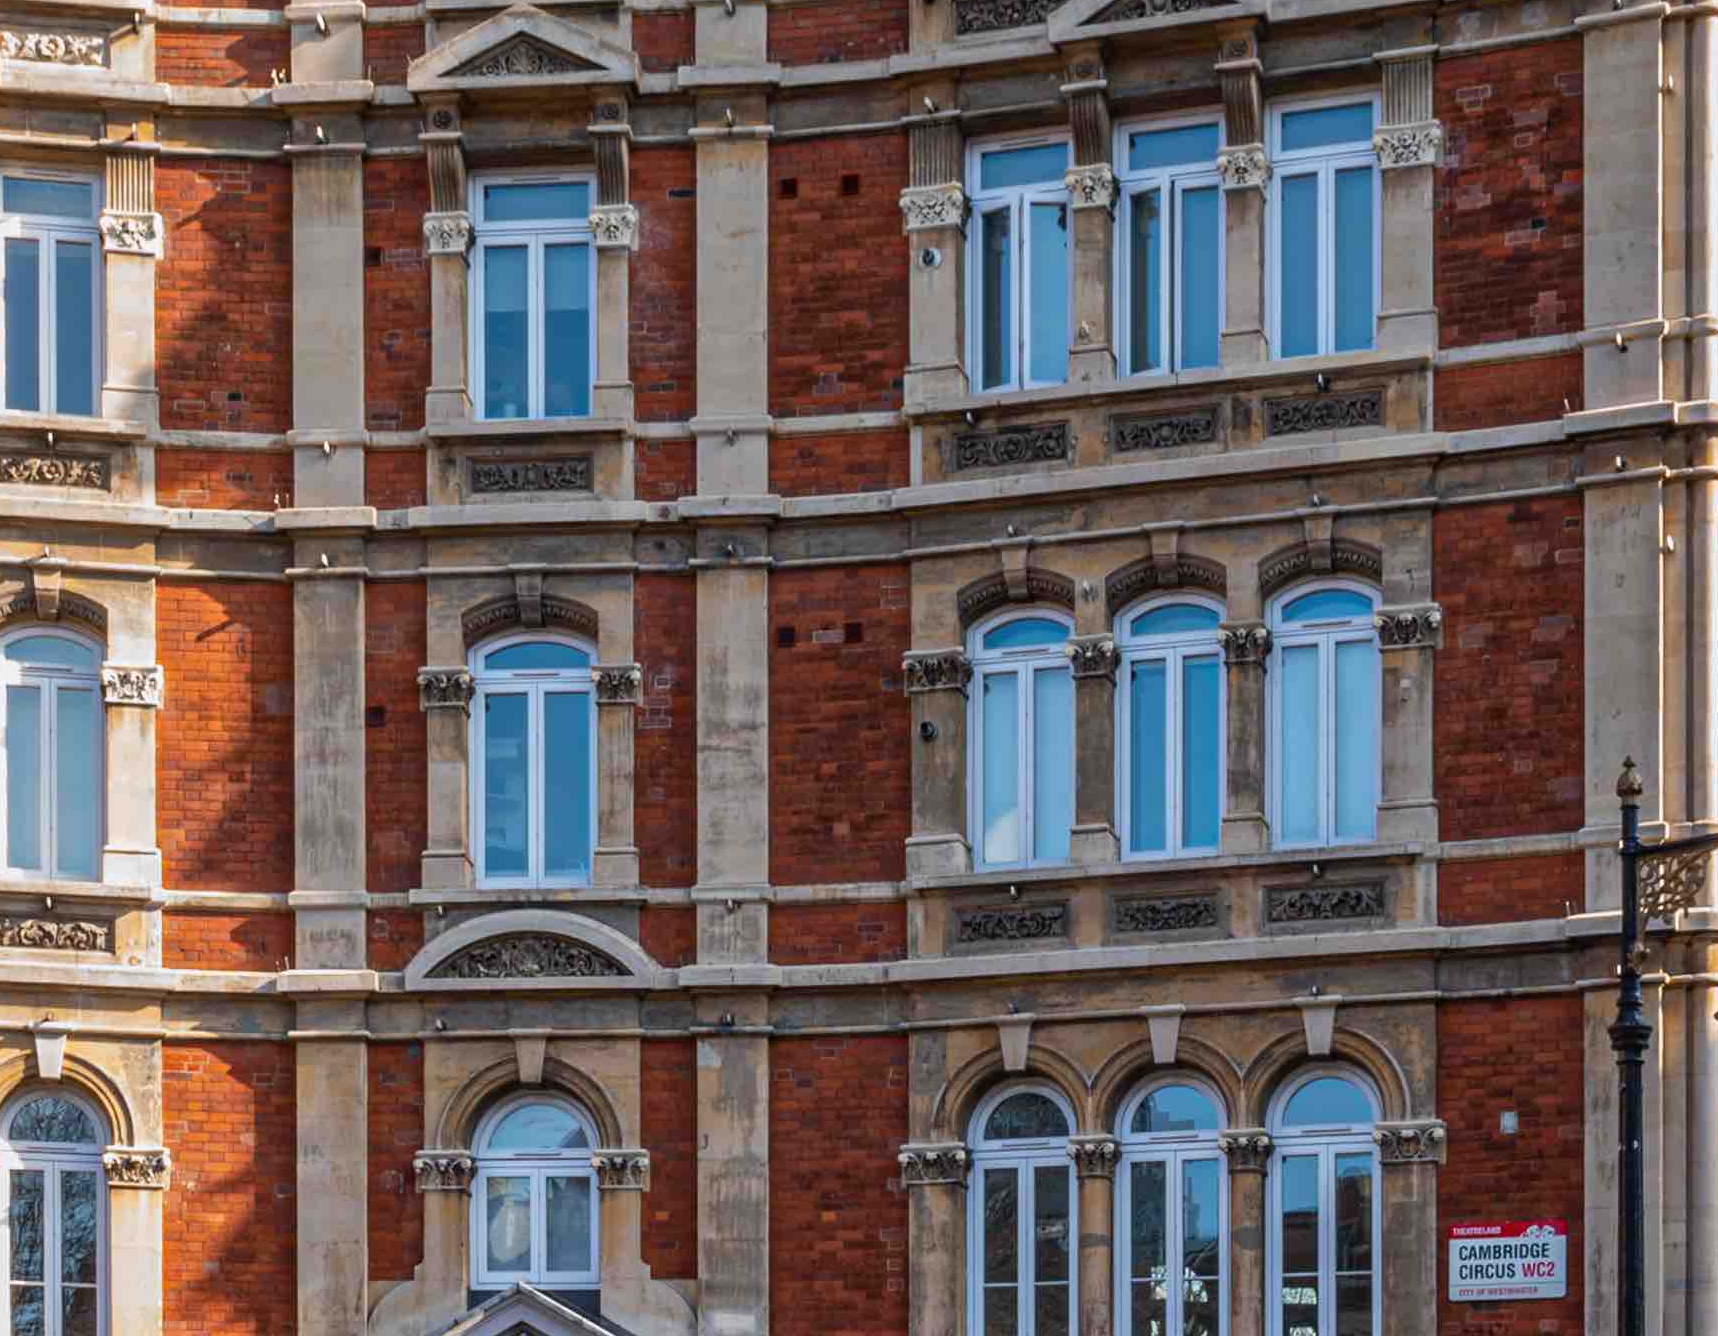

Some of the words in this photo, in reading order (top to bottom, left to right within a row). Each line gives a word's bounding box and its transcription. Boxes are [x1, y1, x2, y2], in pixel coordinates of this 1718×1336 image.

[1459, 1243, 1551, 1261] CAMBRIDGE
[1459, 1263, 1516, 1280] CIRCUS
[1522, 1262, 1555, 1277] WC2
